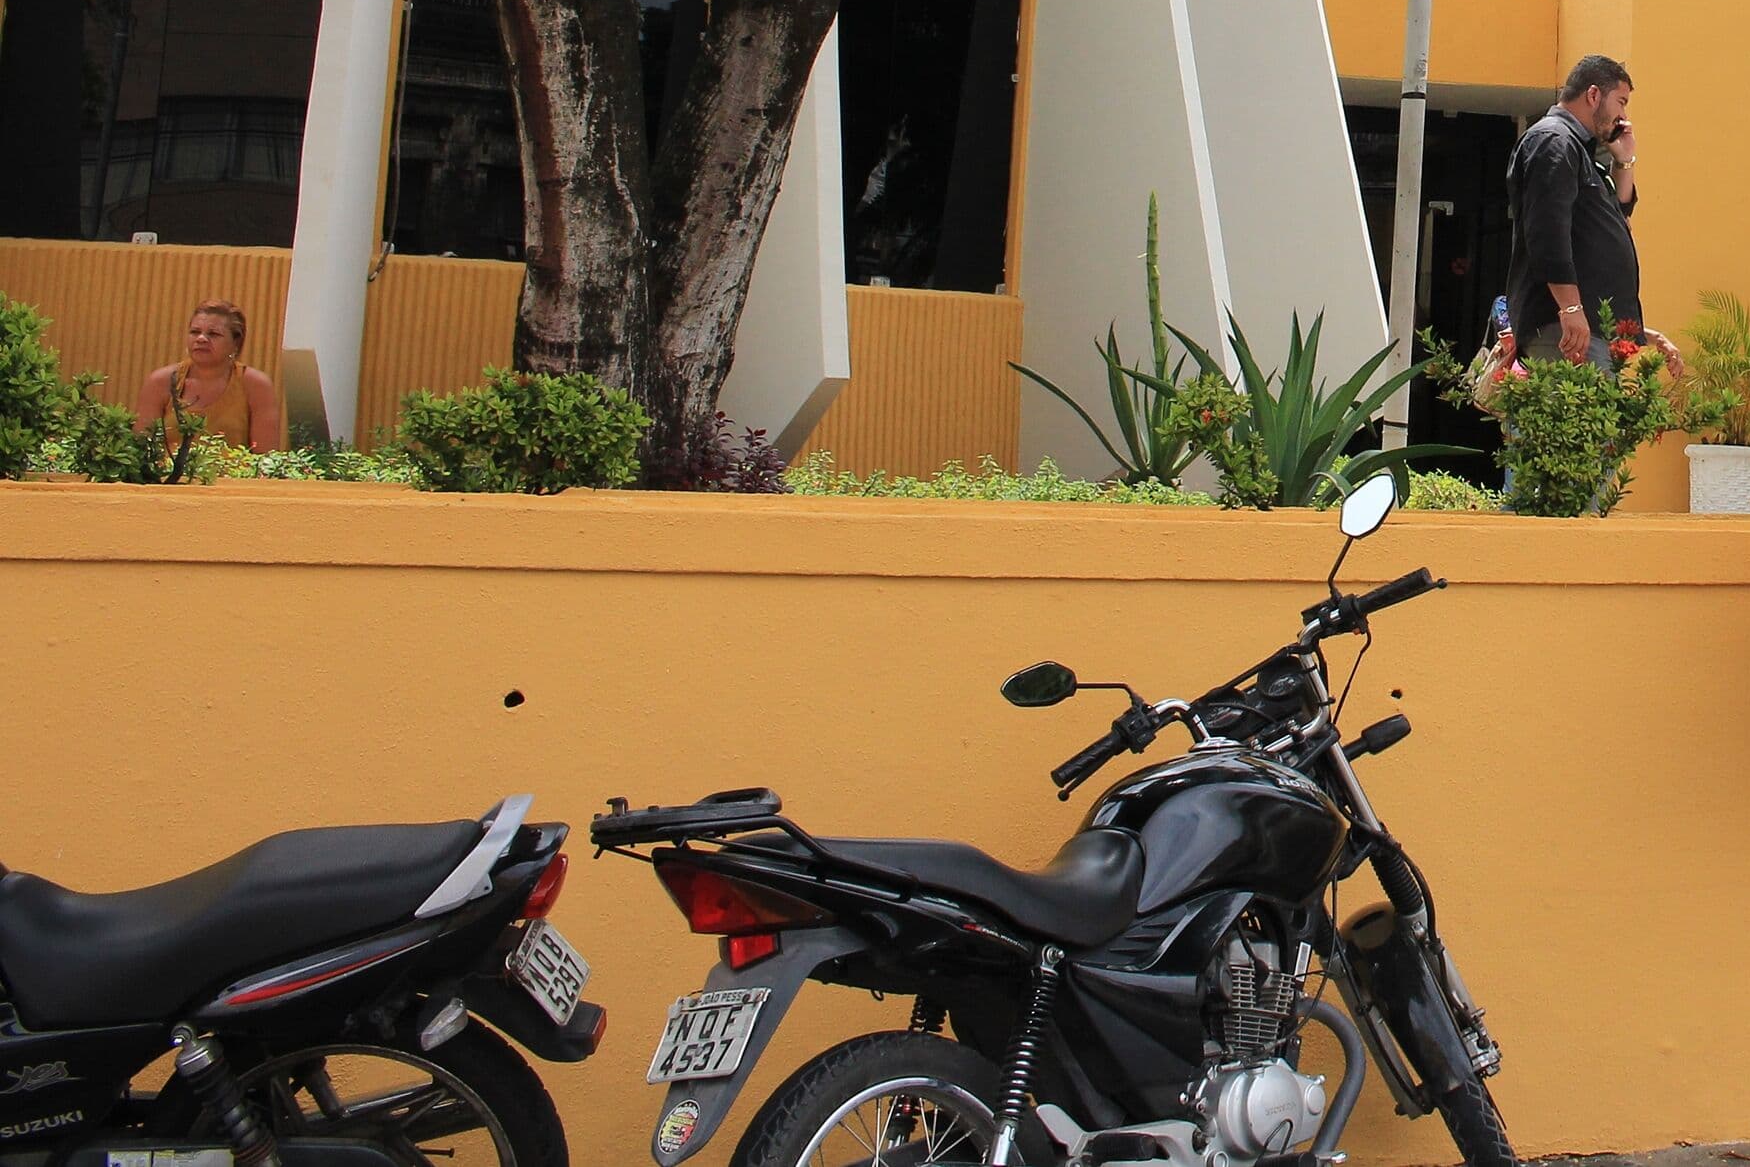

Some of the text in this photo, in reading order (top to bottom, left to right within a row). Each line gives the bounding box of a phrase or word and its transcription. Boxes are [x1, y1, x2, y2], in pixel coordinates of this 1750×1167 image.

[526, 933, 564, 993] NQB
[547, 953, 586, 1014] 5297
[673, 1005, 743, 1045] NQF
[659, 1038, 734, 1076] 4537
[0, 1109, 84, 1138] SUZUKI
